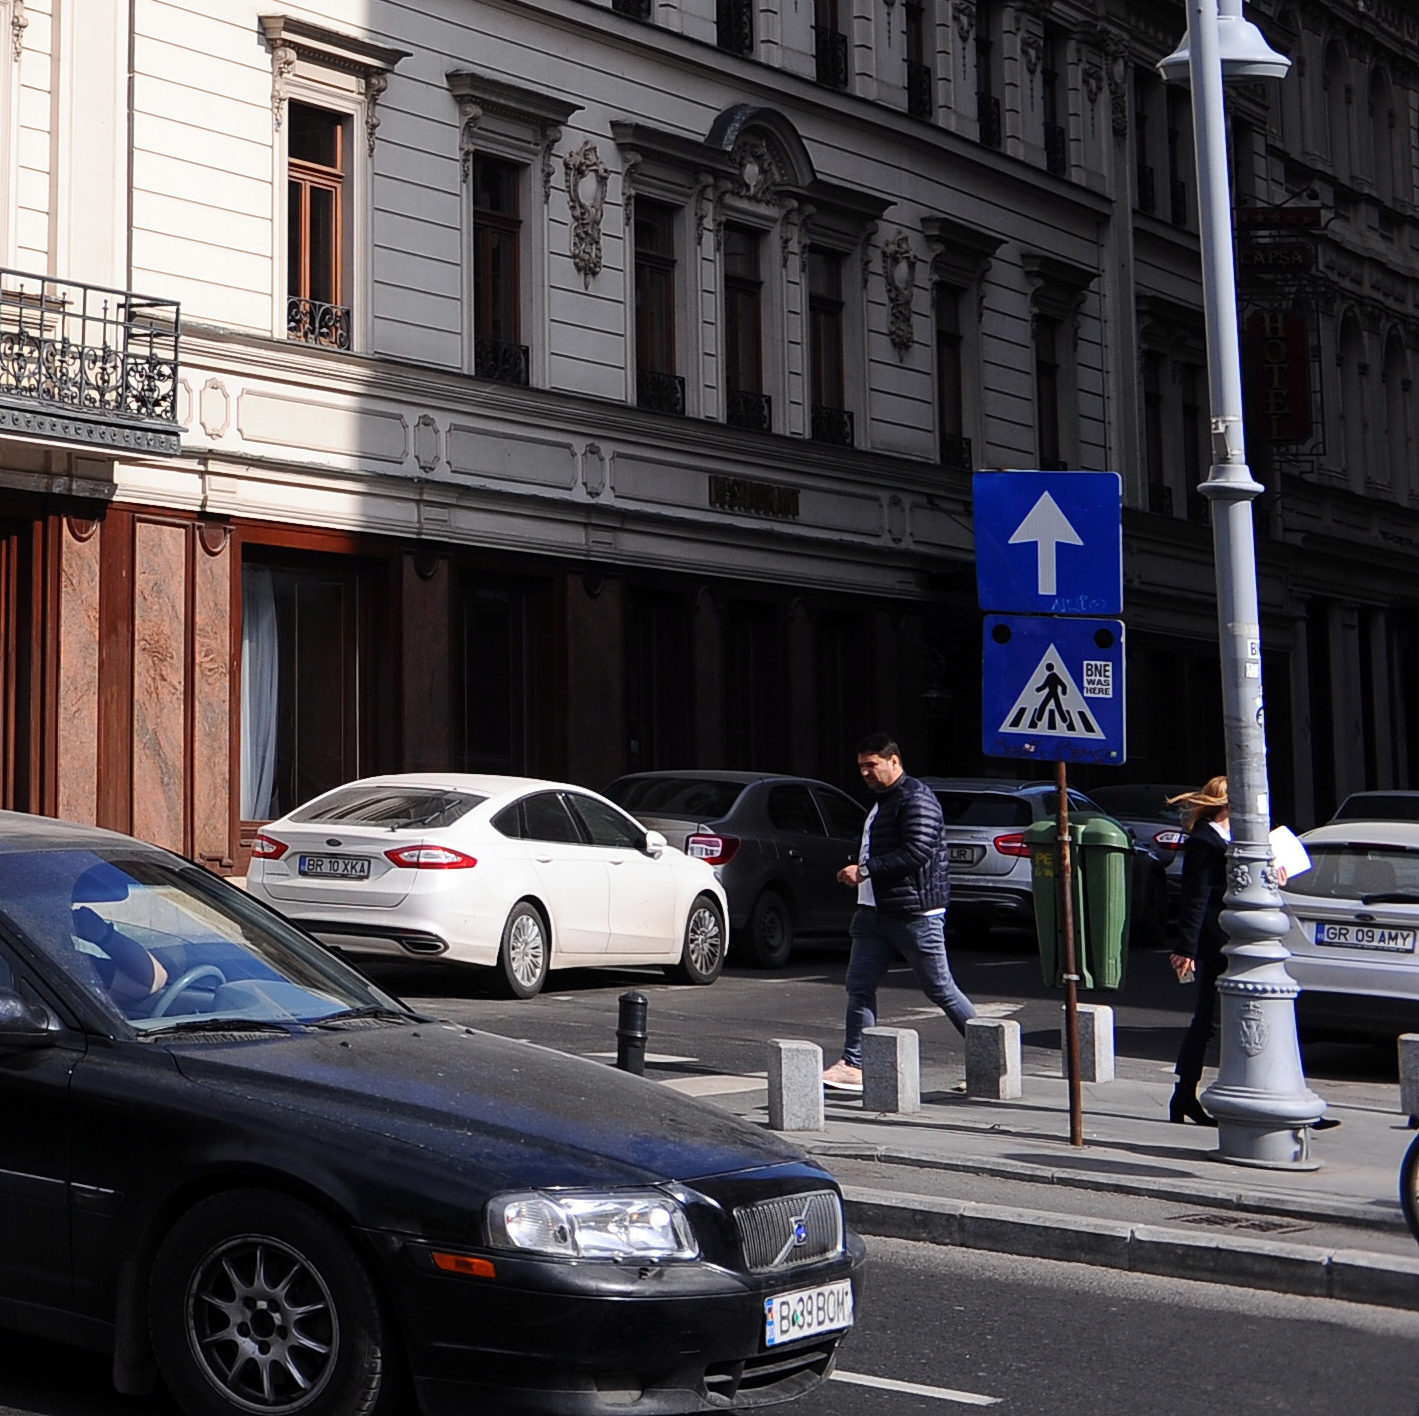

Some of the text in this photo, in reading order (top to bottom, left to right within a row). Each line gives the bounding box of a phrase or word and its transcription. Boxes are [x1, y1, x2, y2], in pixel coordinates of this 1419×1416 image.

[1263, 313, 1294, 441] HOTEL
[1085, 663, 1111, 678] BNE
[1086, 678, 1110, 687] WAS
[1084, 687, 1111, 696] HERE
[307, 858, 324, 872] BR
[328, 859, 340, 872] 10
[342, 860, 366, 874] XKA
[1326, 926, 1411, 946] GR 09 AMY
[779, 1300, 790, 1336] B
[797, 1294, 814, 1329] 39
